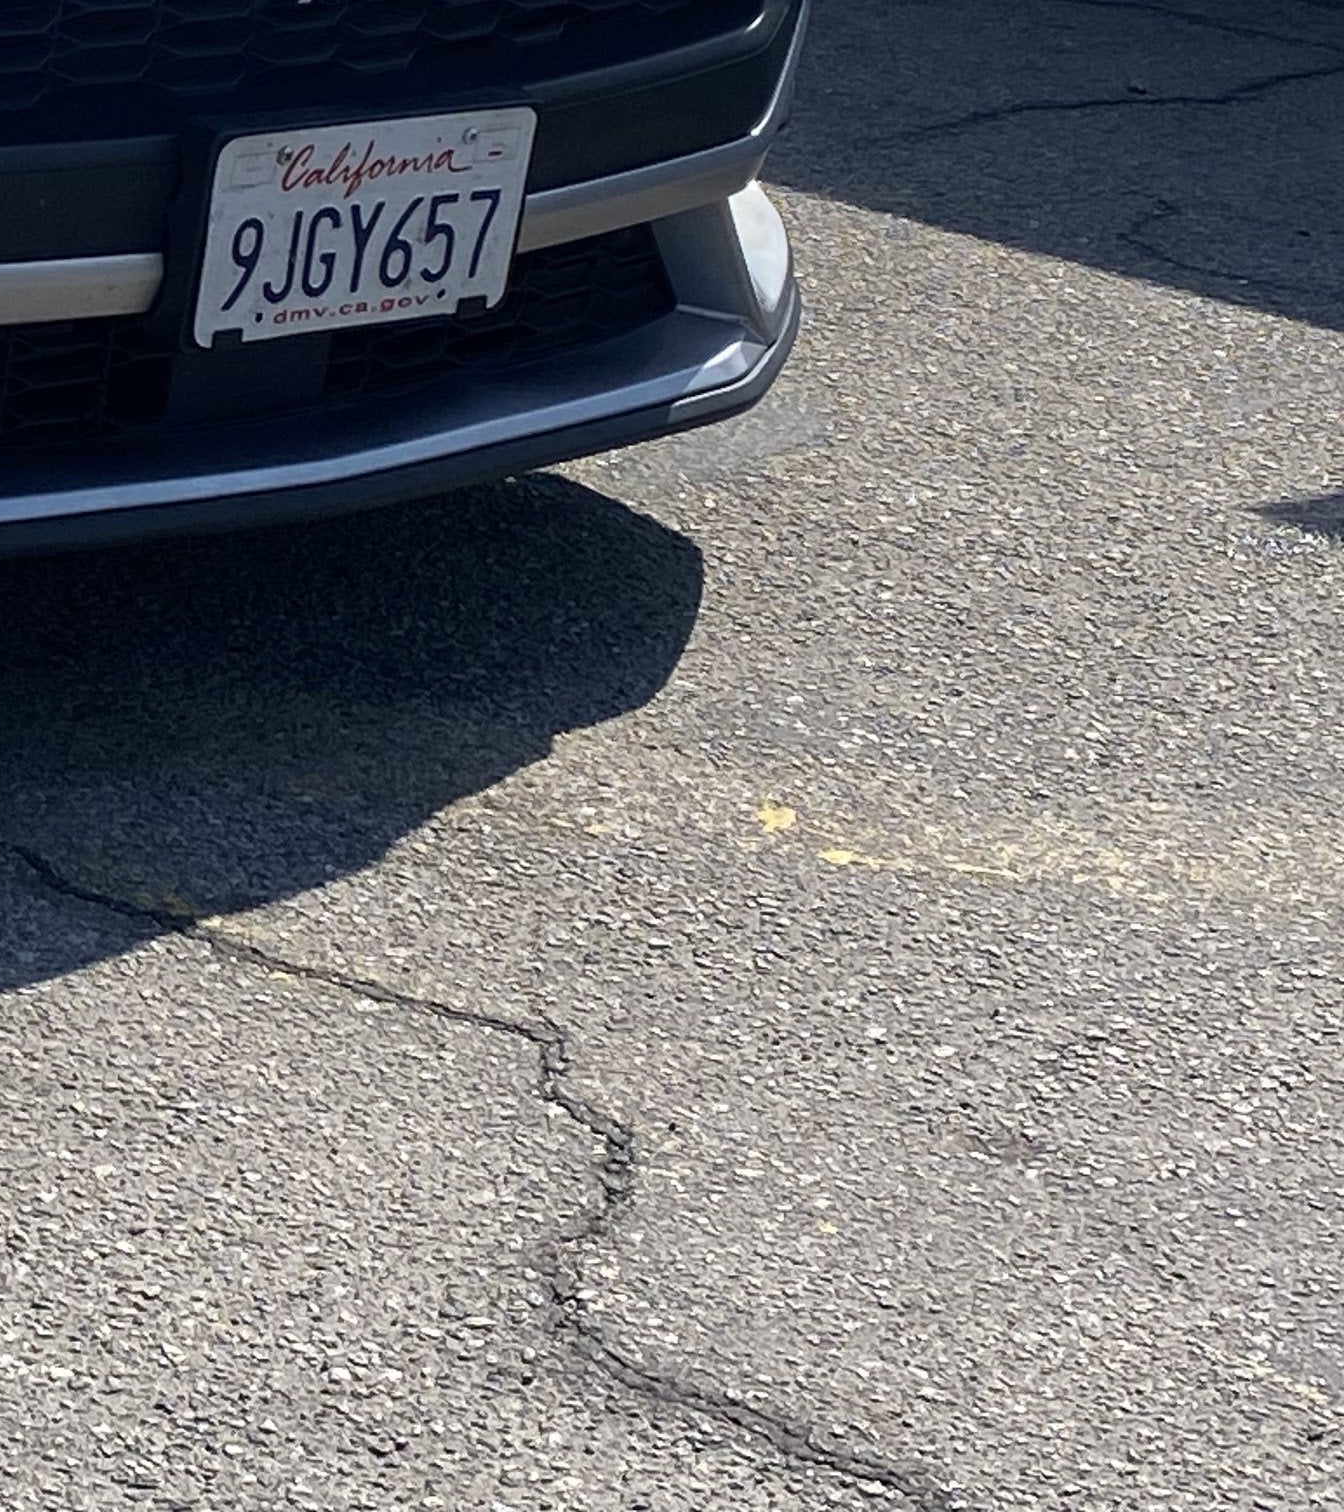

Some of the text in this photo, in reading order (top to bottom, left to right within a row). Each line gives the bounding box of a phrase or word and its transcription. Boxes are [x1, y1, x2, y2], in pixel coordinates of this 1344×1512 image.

[281, 140, 474, 200] California
[221, 188, 501, 312] 9JGY657
[272, 292, 430, 325] dmv.ca.gov
